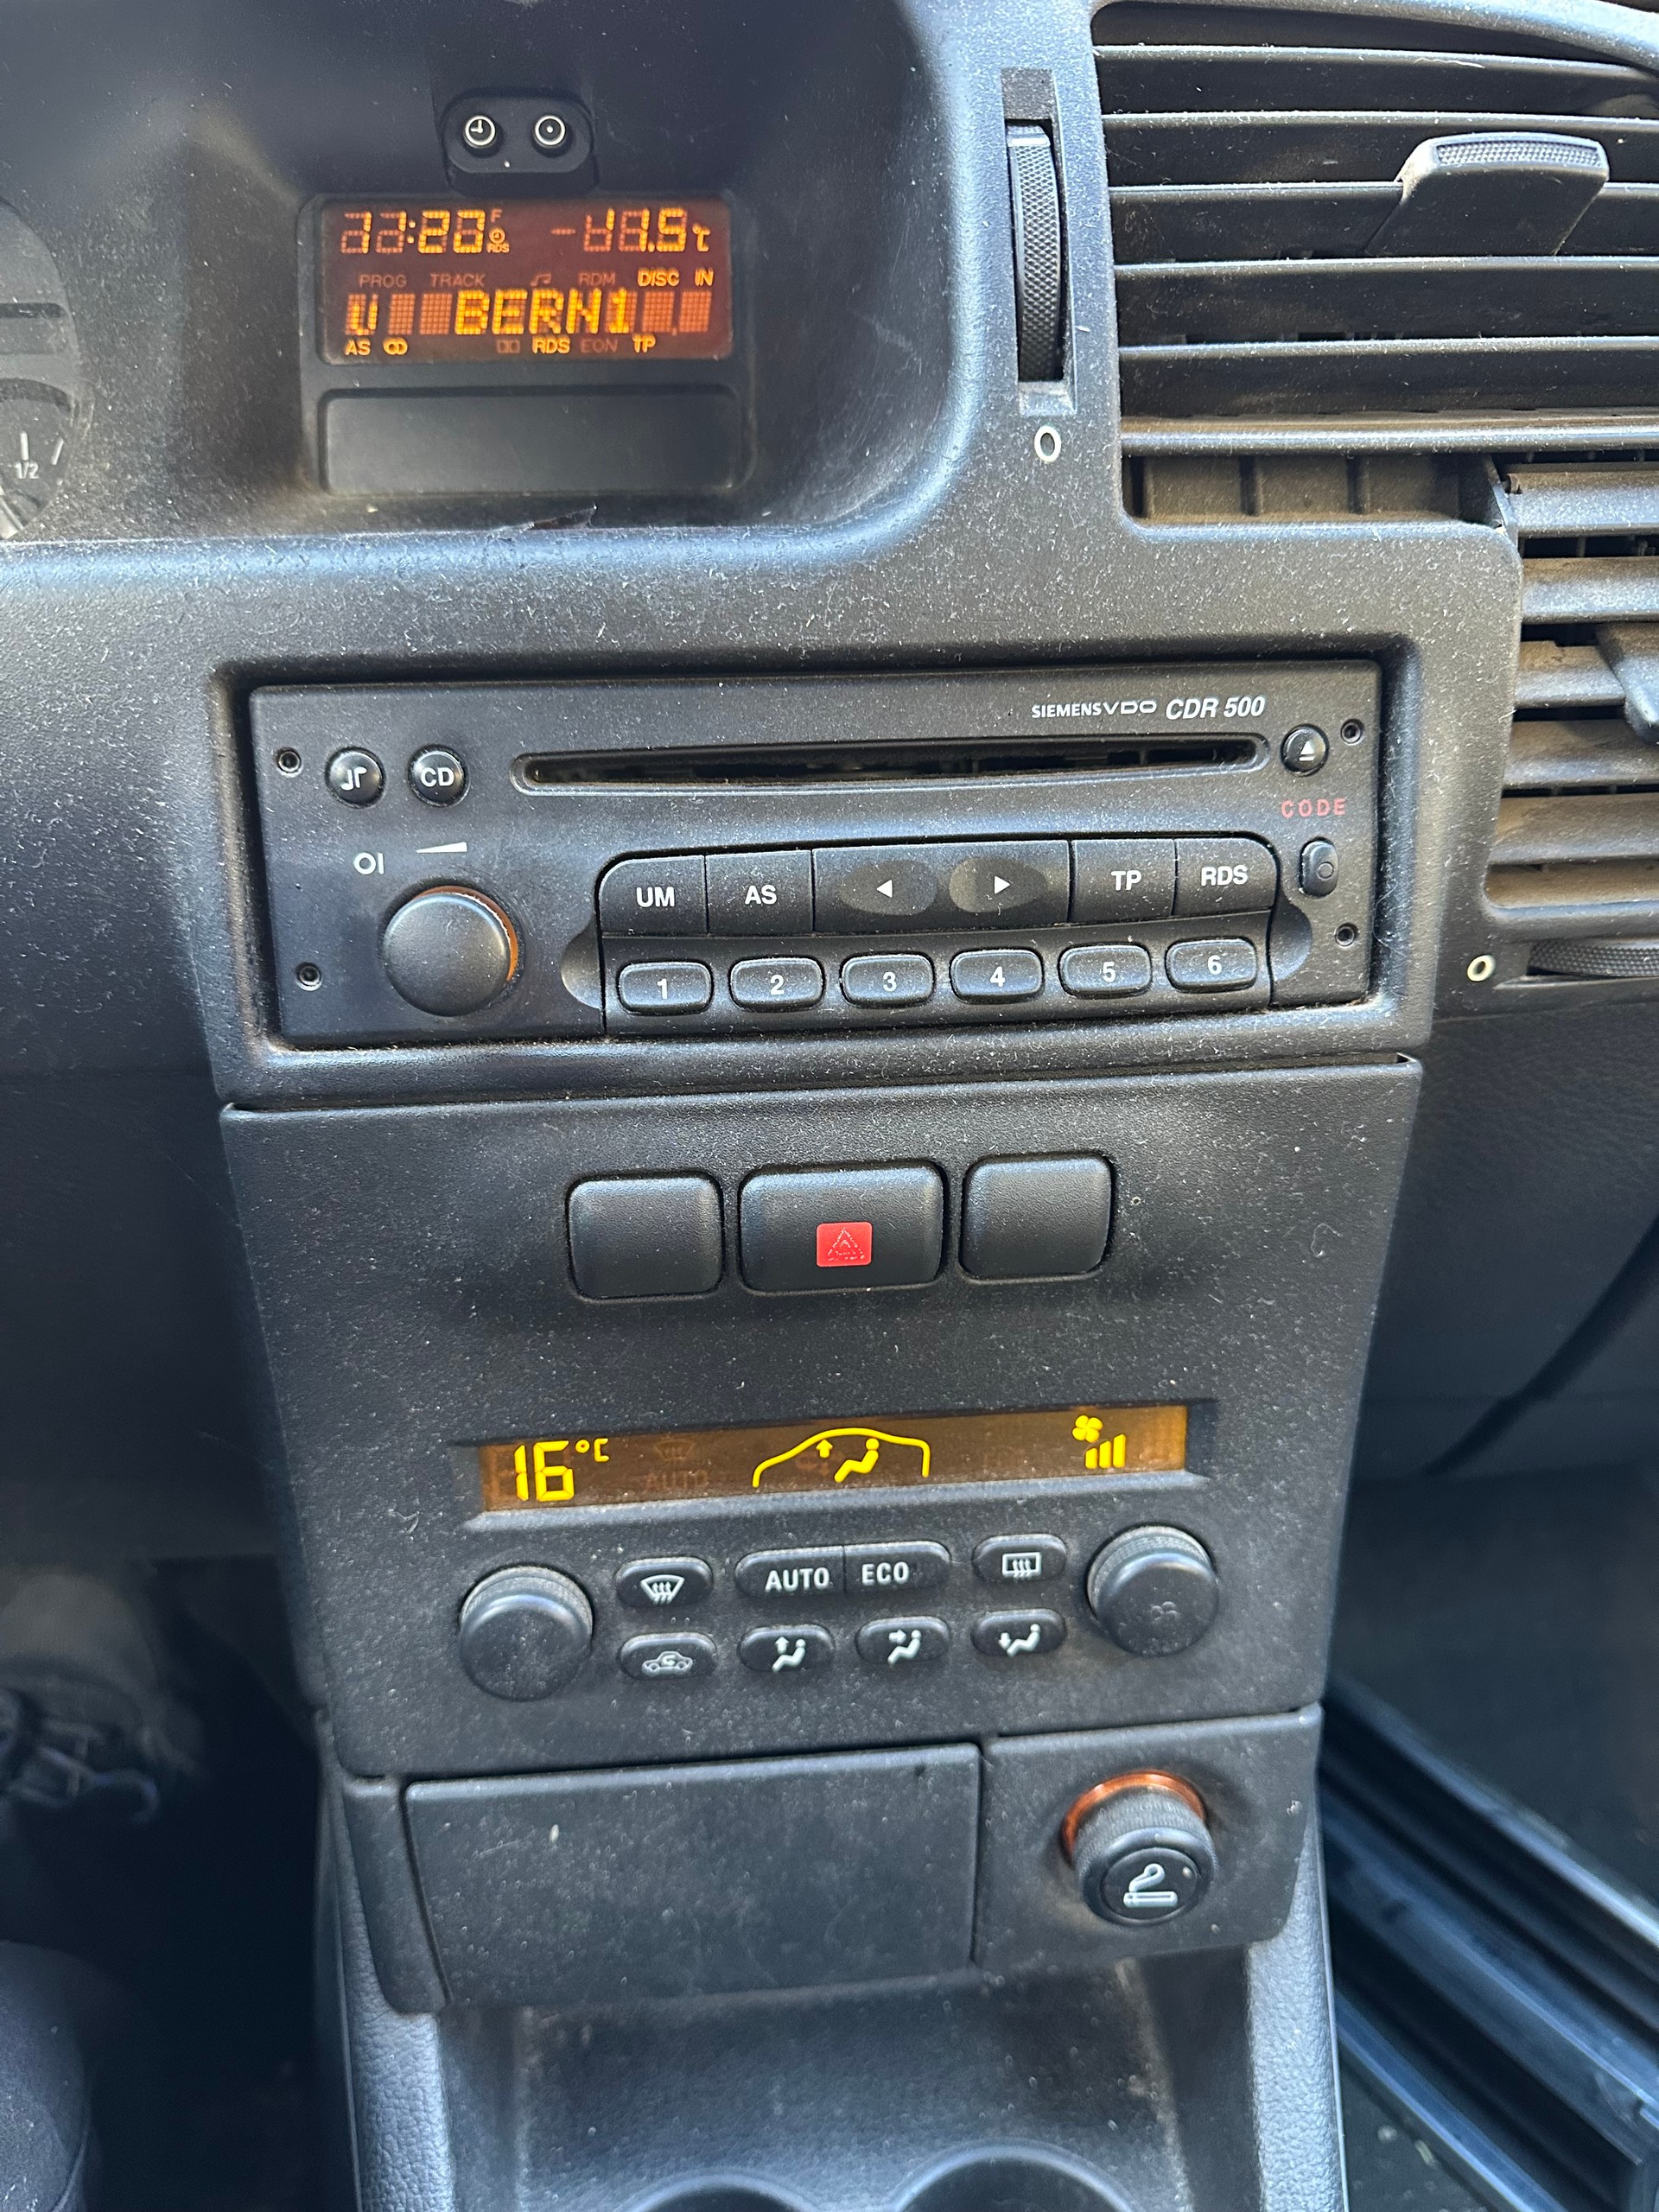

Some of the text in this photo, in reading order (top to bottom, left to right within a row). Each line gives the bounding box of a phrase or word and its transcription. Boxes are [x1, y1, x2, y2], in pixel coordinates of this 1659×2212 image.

[359, 274, 407, 288] PROG
[430, 273, 486, 288] TRACK
[578, 272, 616, 286] RDM
[637, 267, 714, 287] DISC IN
[346, 338, 372, 356] AS
[531, 334, 570, 354] RDS
[580, 339, 618, 353] EON
[632, 334, 656, 353] TP
[1166, 697, 1219, 720] CDR
[1223, 696, 1266, 718] 500
[420, 766, 454, 787] CD
[1281, 798, 1347, 819] CODE
[1110, 870, 1142, 892] TP
[1200, 866, 1249, 887] RDS
[636, 887, 676, 907] UM
[744, 885, 778, 906] AS
[1102, 962, 1116, 982] 5
[1207, 955, 1223, 975] 6
[770, 975, 785, 995] 2
[882, 971, 897, 992] 3
[989, 966, 1006, 988] 4
[657, 978, 669, 1000] 1
[765, 1567, 830, 1592] AUTO
[861, 1561, 910, 1586] ECO
